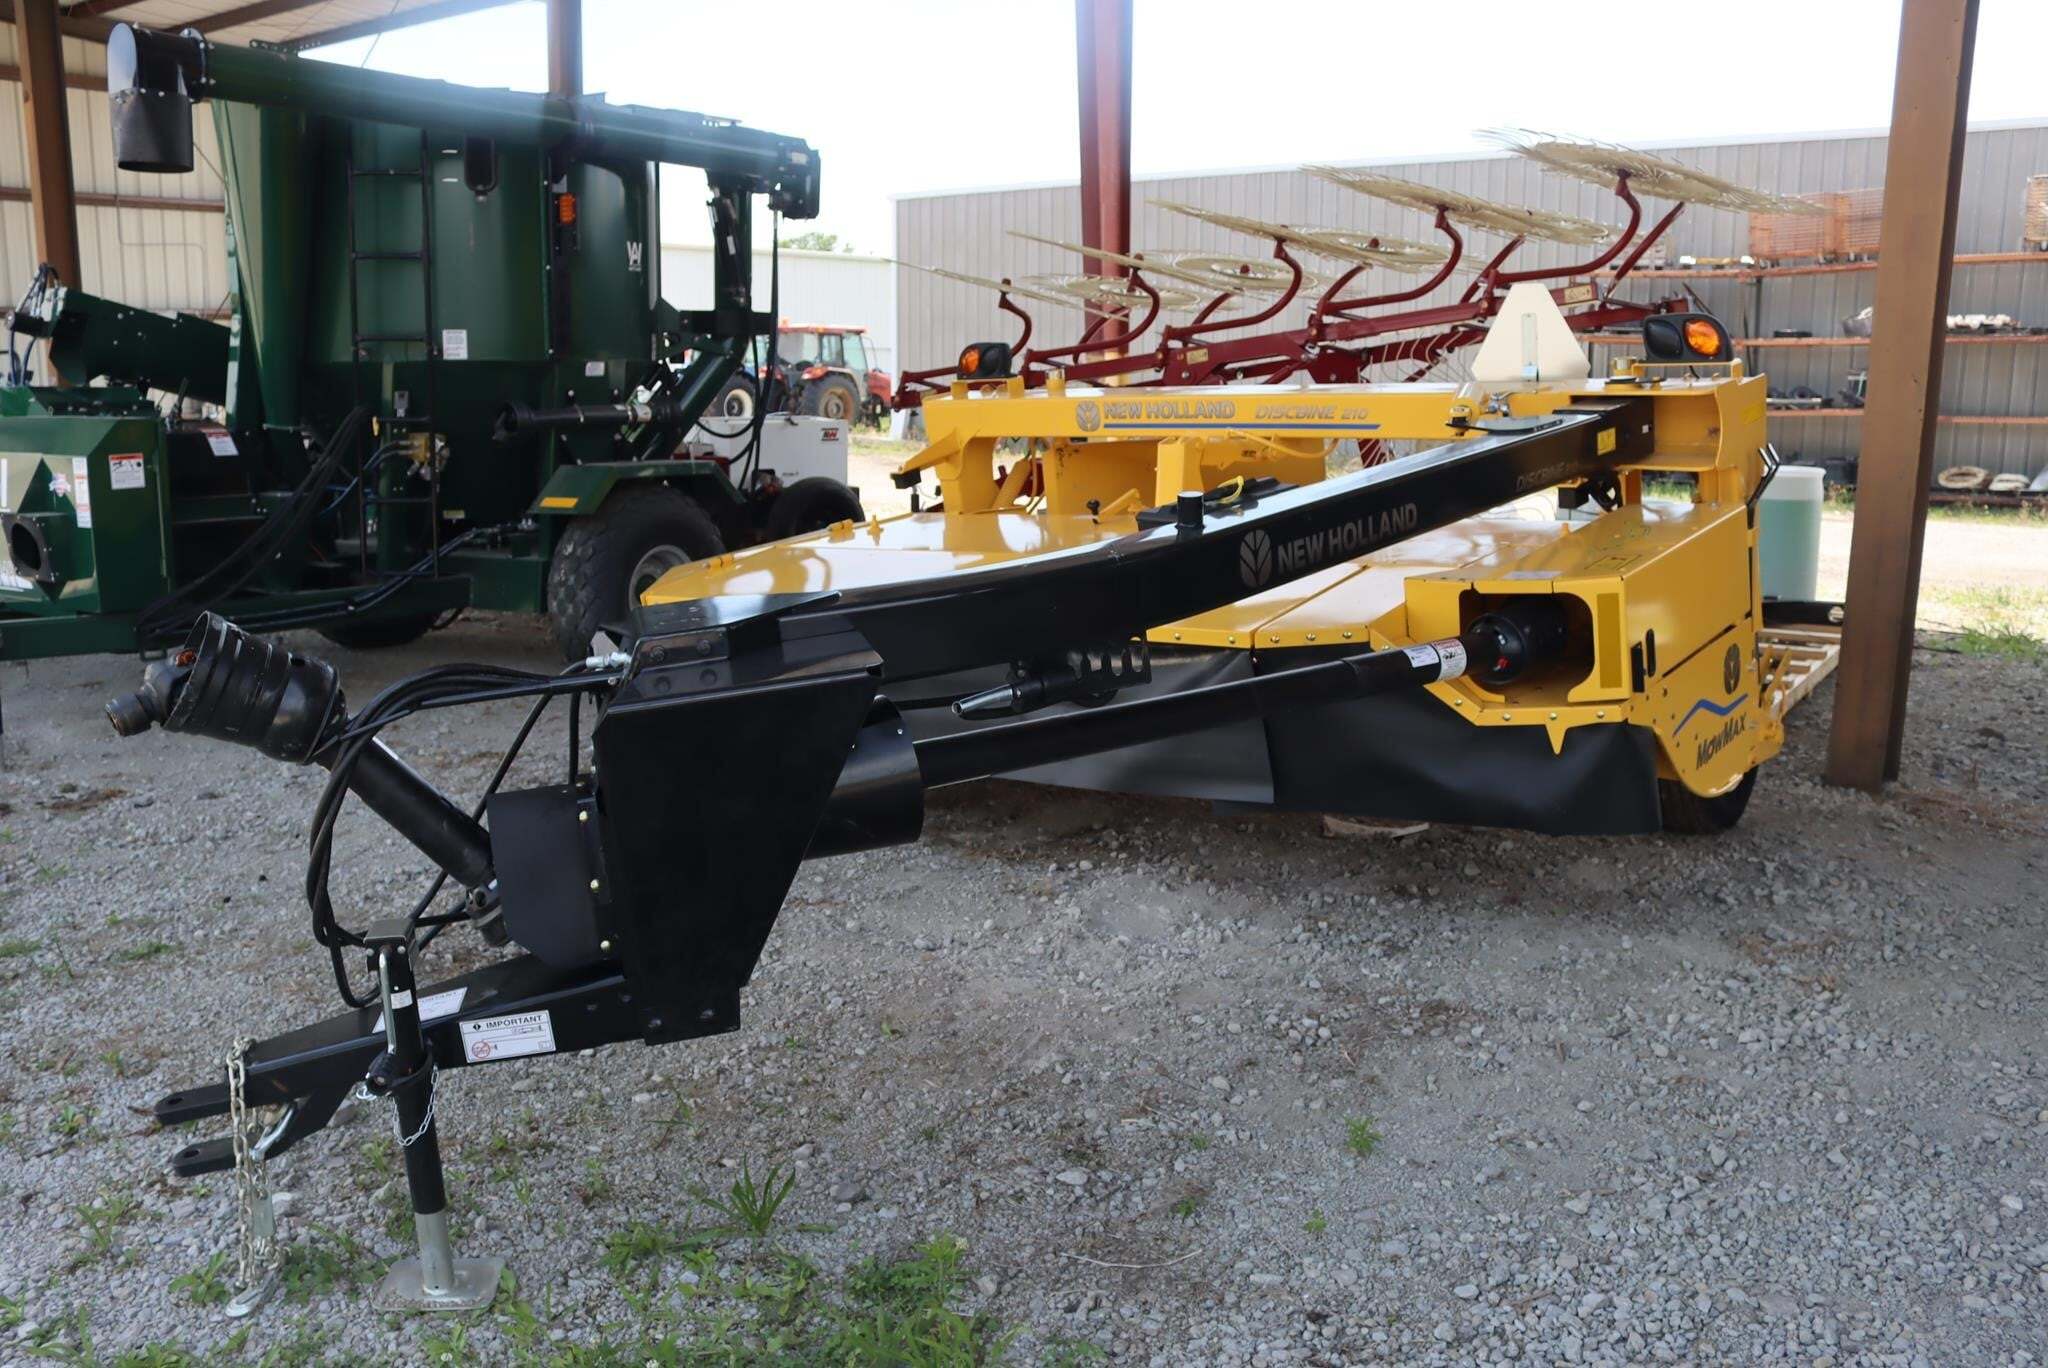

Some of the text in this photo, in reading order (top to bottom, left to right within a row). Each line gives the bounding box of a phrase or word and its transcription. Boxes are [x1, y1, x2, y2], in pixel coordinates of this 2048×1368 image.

[1103, 400, 1370, 420] NEW HOLLAND DISCBINE 210
[1277, 502, 1418, 572] NEW HOLLAND
[485, 1015, 542, 1029] IMPORTANT
